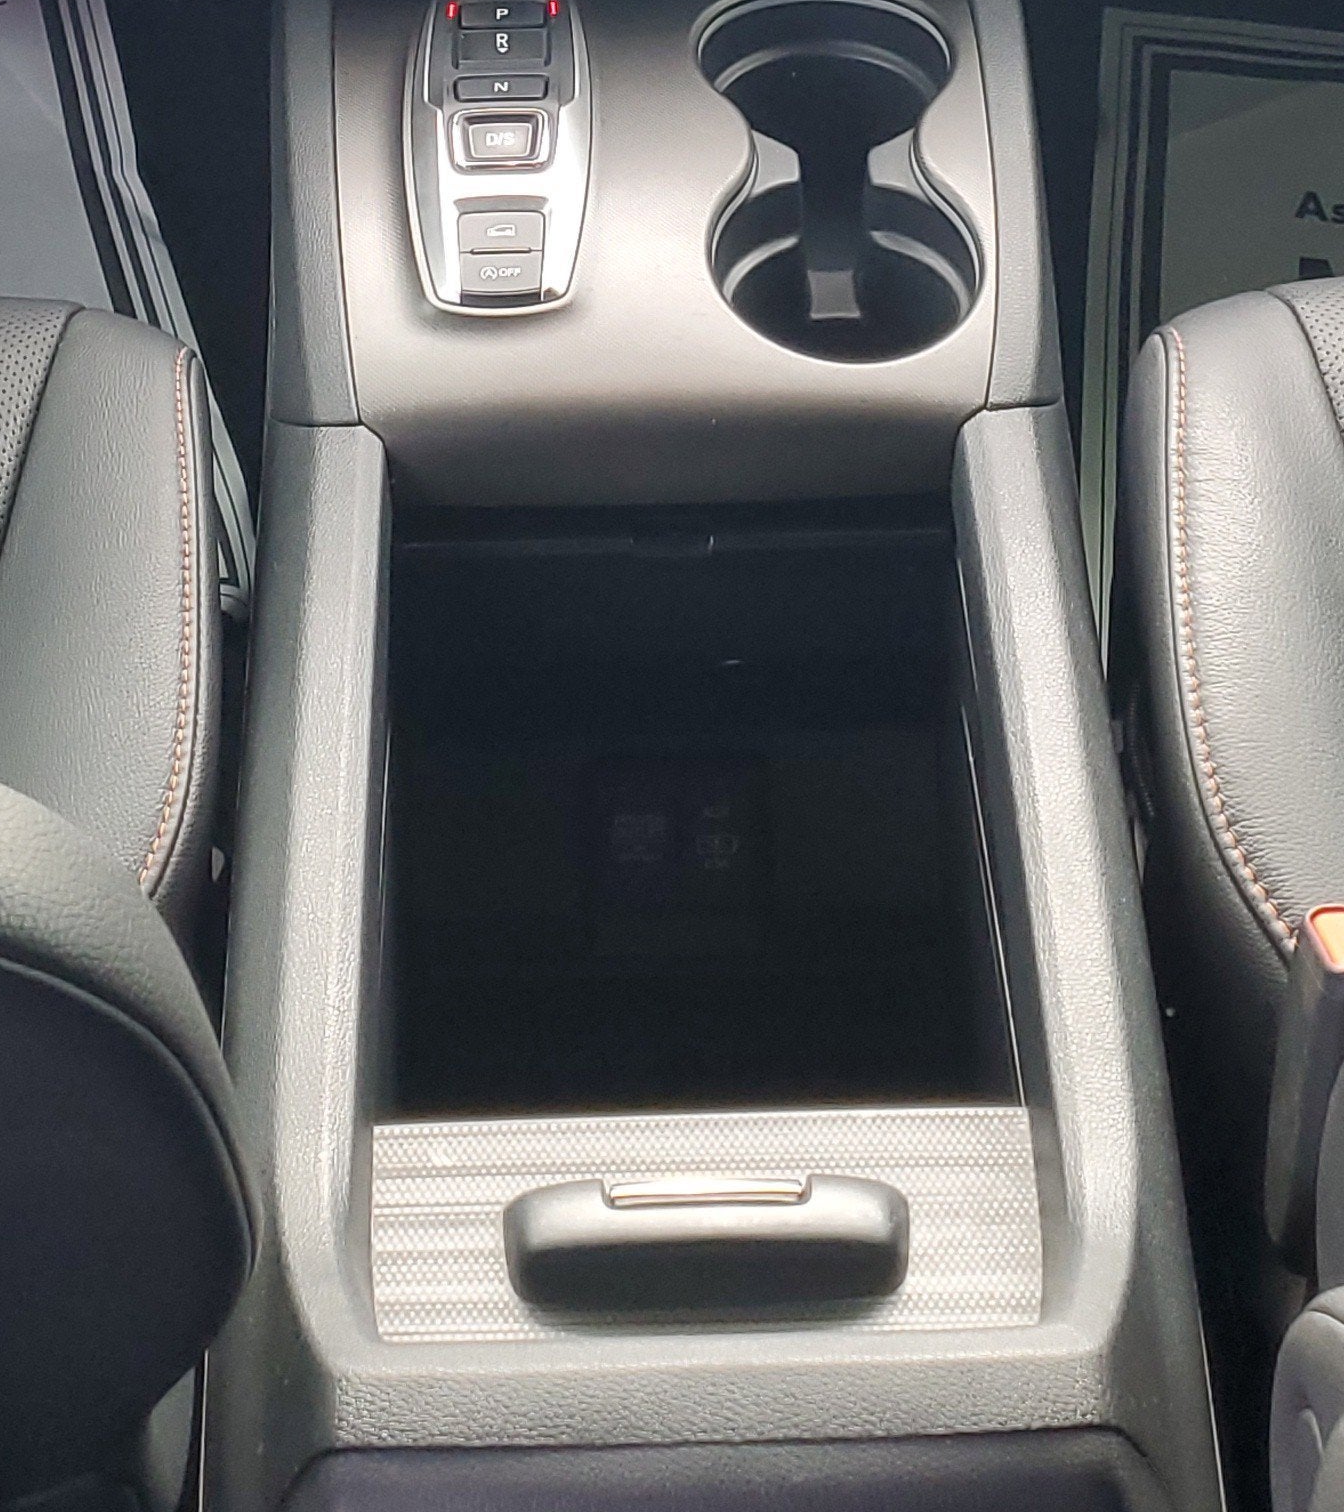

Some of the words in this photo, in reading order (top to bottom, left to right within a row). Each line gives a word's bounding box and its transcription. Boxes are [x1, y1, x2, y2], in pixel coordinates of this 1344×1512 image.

[495, 8, 509, 21] P
[495, 32, 509, 48] R
[493, 81, 510, 93] N
[499, 266, 520, 278] OFF
